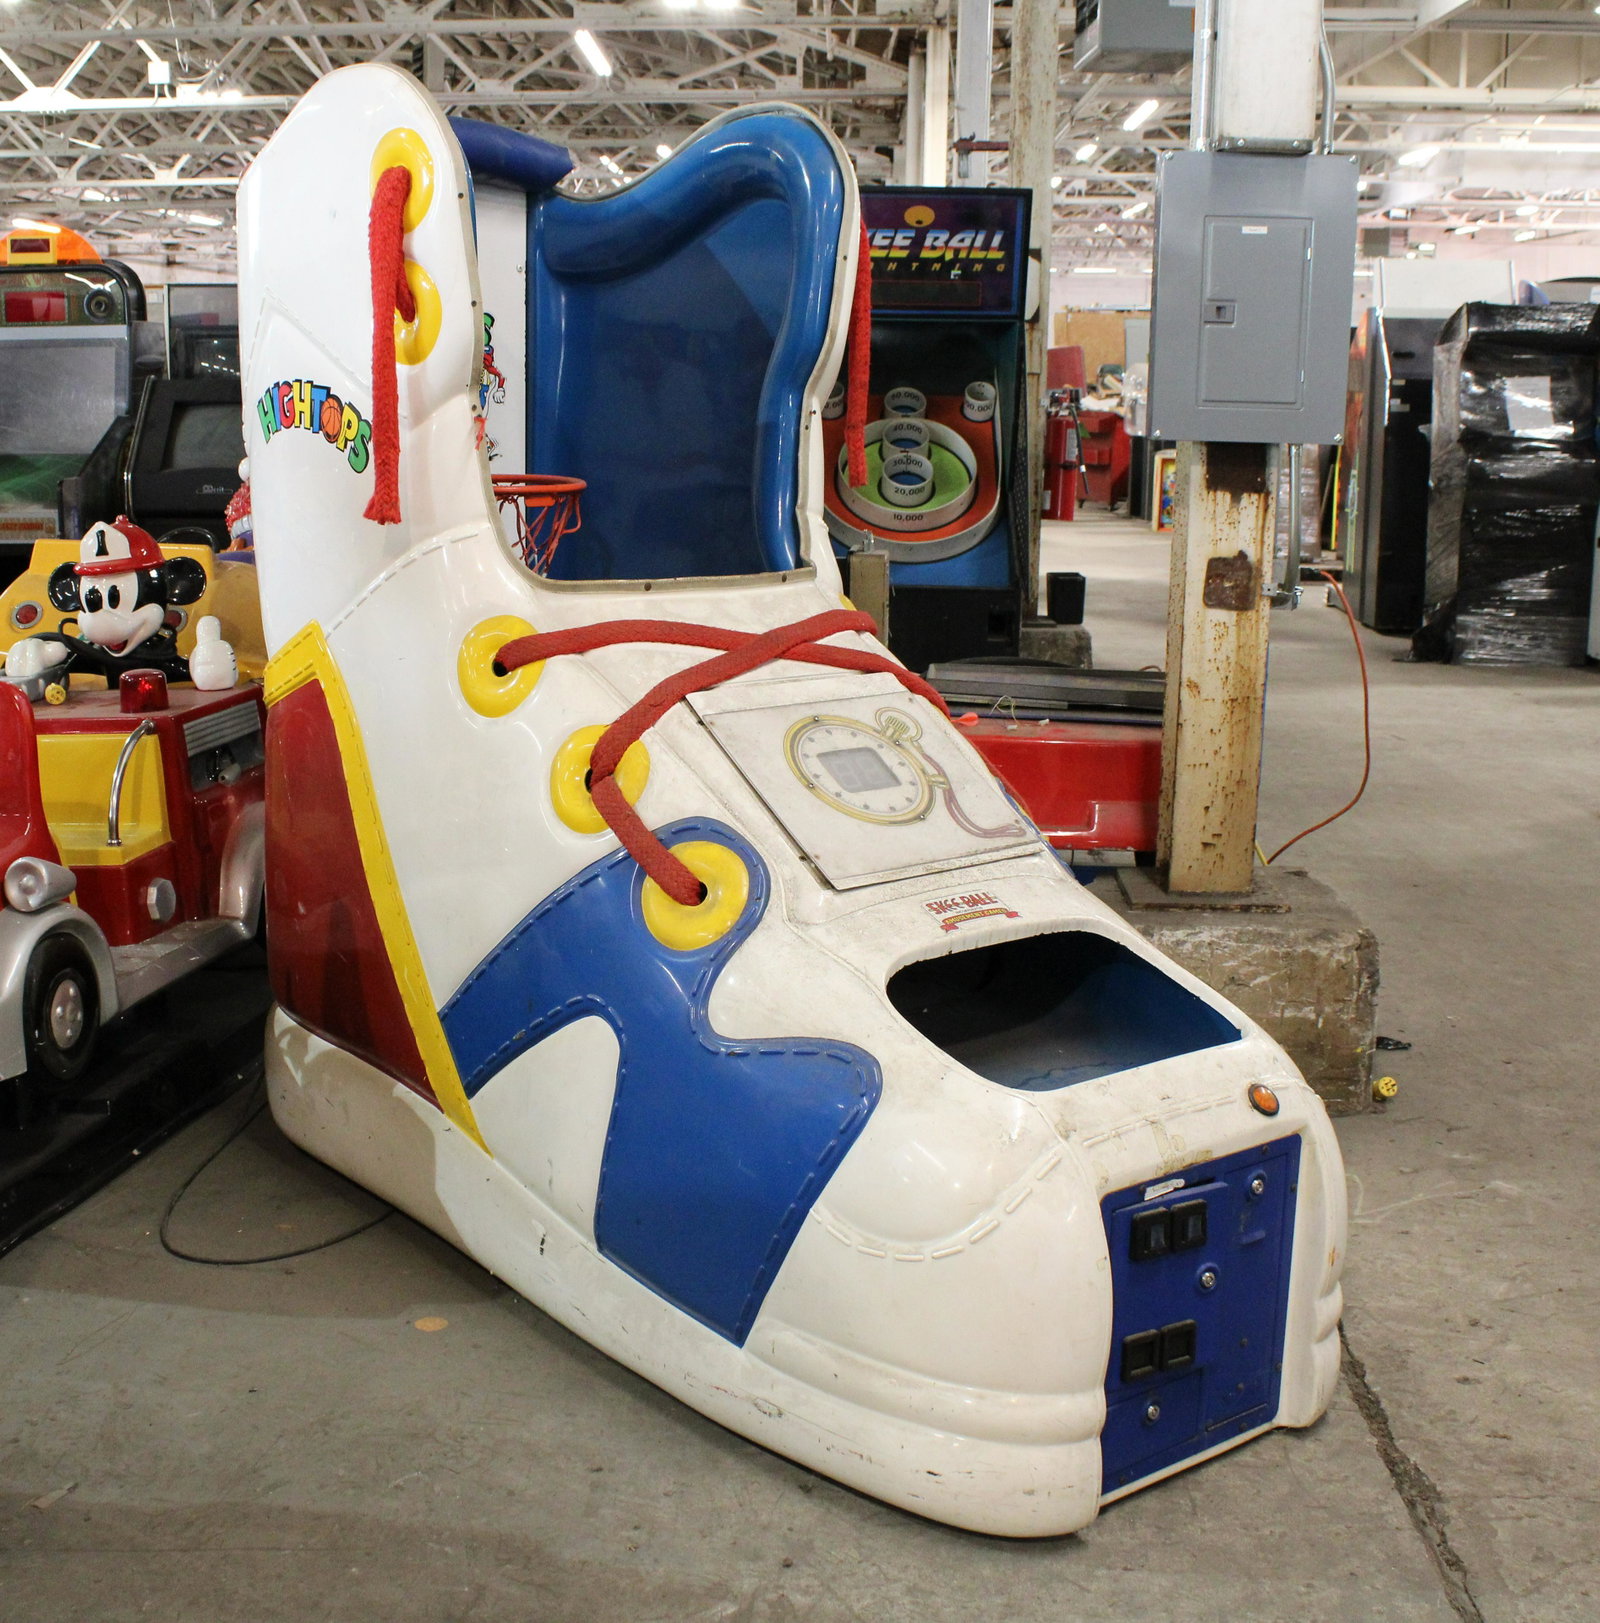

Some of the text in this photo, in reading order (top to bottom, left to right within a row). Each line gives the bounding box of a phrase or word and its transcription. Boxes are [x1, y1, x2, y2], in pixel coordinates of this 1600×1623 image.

[920, 229, 1005, 261] BALL
[257, 379, 372, 473] HIGHTOPS
[894, 486, 925, 496] 20,000
[893, 513, 924, 522] 10,000
